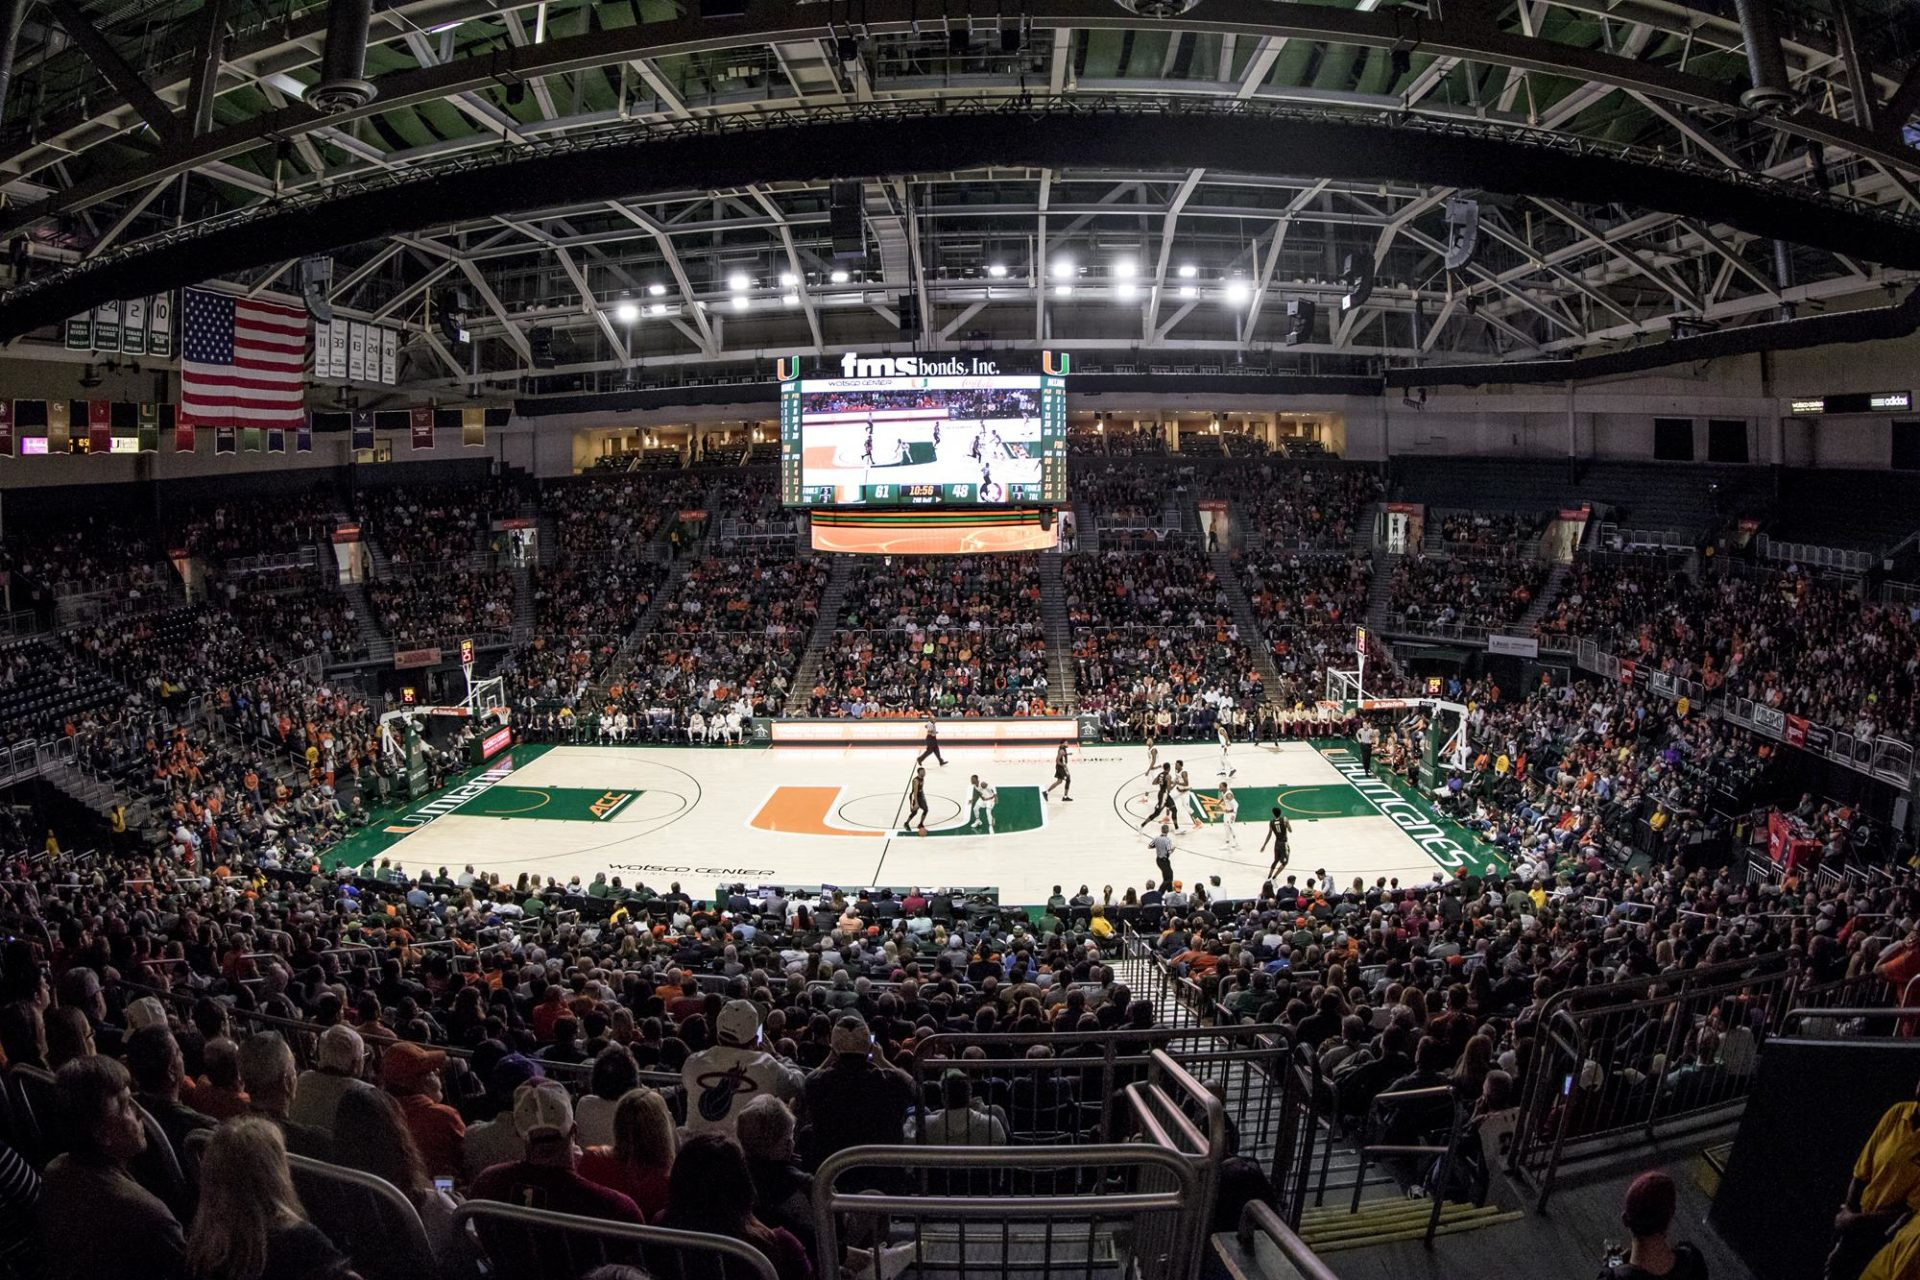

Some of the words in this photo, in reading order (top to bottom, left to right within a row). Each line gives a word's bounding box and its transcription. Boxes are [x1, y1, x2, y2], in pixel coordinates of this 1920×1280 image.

[156, 303, 167, 320] 10
[333, 337, 345, 349] 33
[353, 341, 362, 352] 13
[367, 343, 379, 355] 24
[777, 355, 800, 381] U
[972, 358, 1000, 375] Inc.
[1885, 396, 1908, 406] adidas
[874, 486, 890, 498] 61
[909, 485, 935, 496] 10:56
[952, 485, 970, 498] 48
[588, 791, 627, 817] ACC
